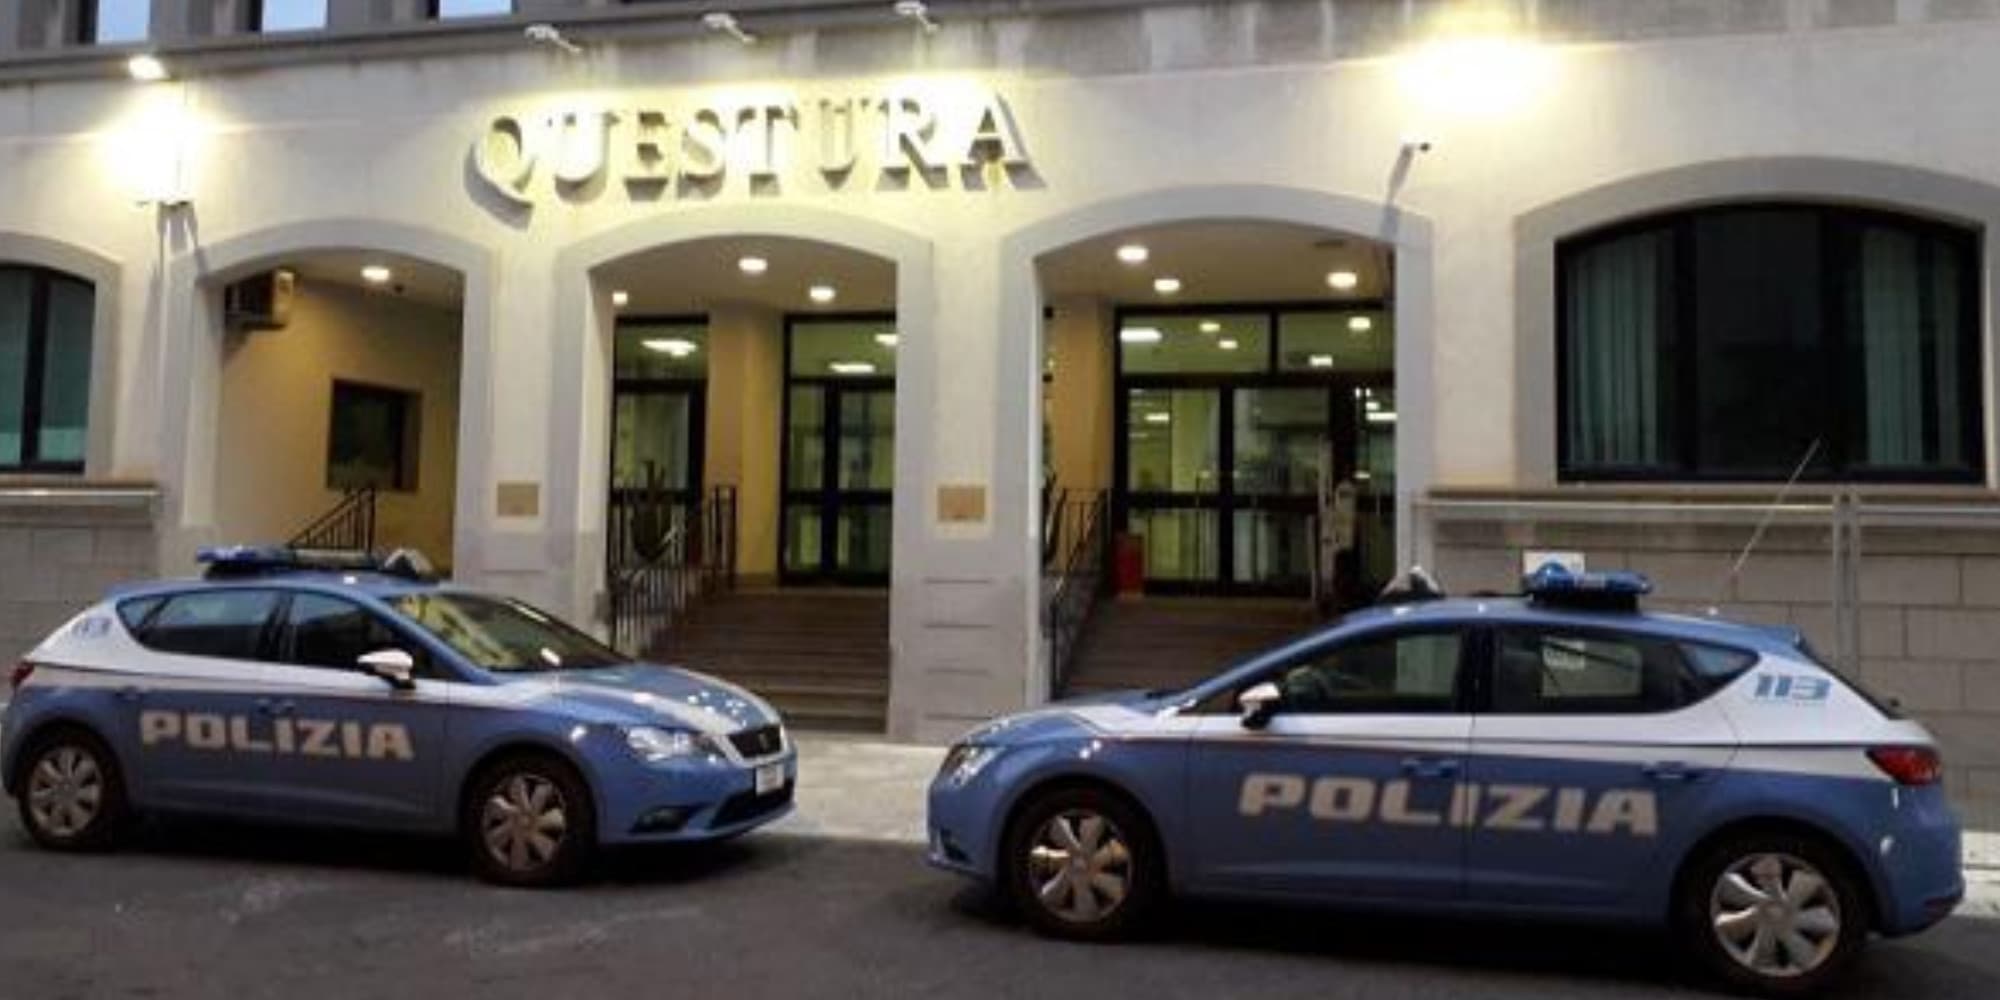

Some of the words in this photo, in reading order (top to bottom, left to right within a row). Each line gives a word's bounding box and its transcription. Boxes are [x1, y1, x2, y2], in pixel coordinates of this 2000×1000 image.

[468, 91, 1034, 215] QUESTURA
[1754, 674, 1831, 700] 113
[140, 709, 415, 760] POLIZIA
[1239, 773, 1658, 835] POLIZIA
